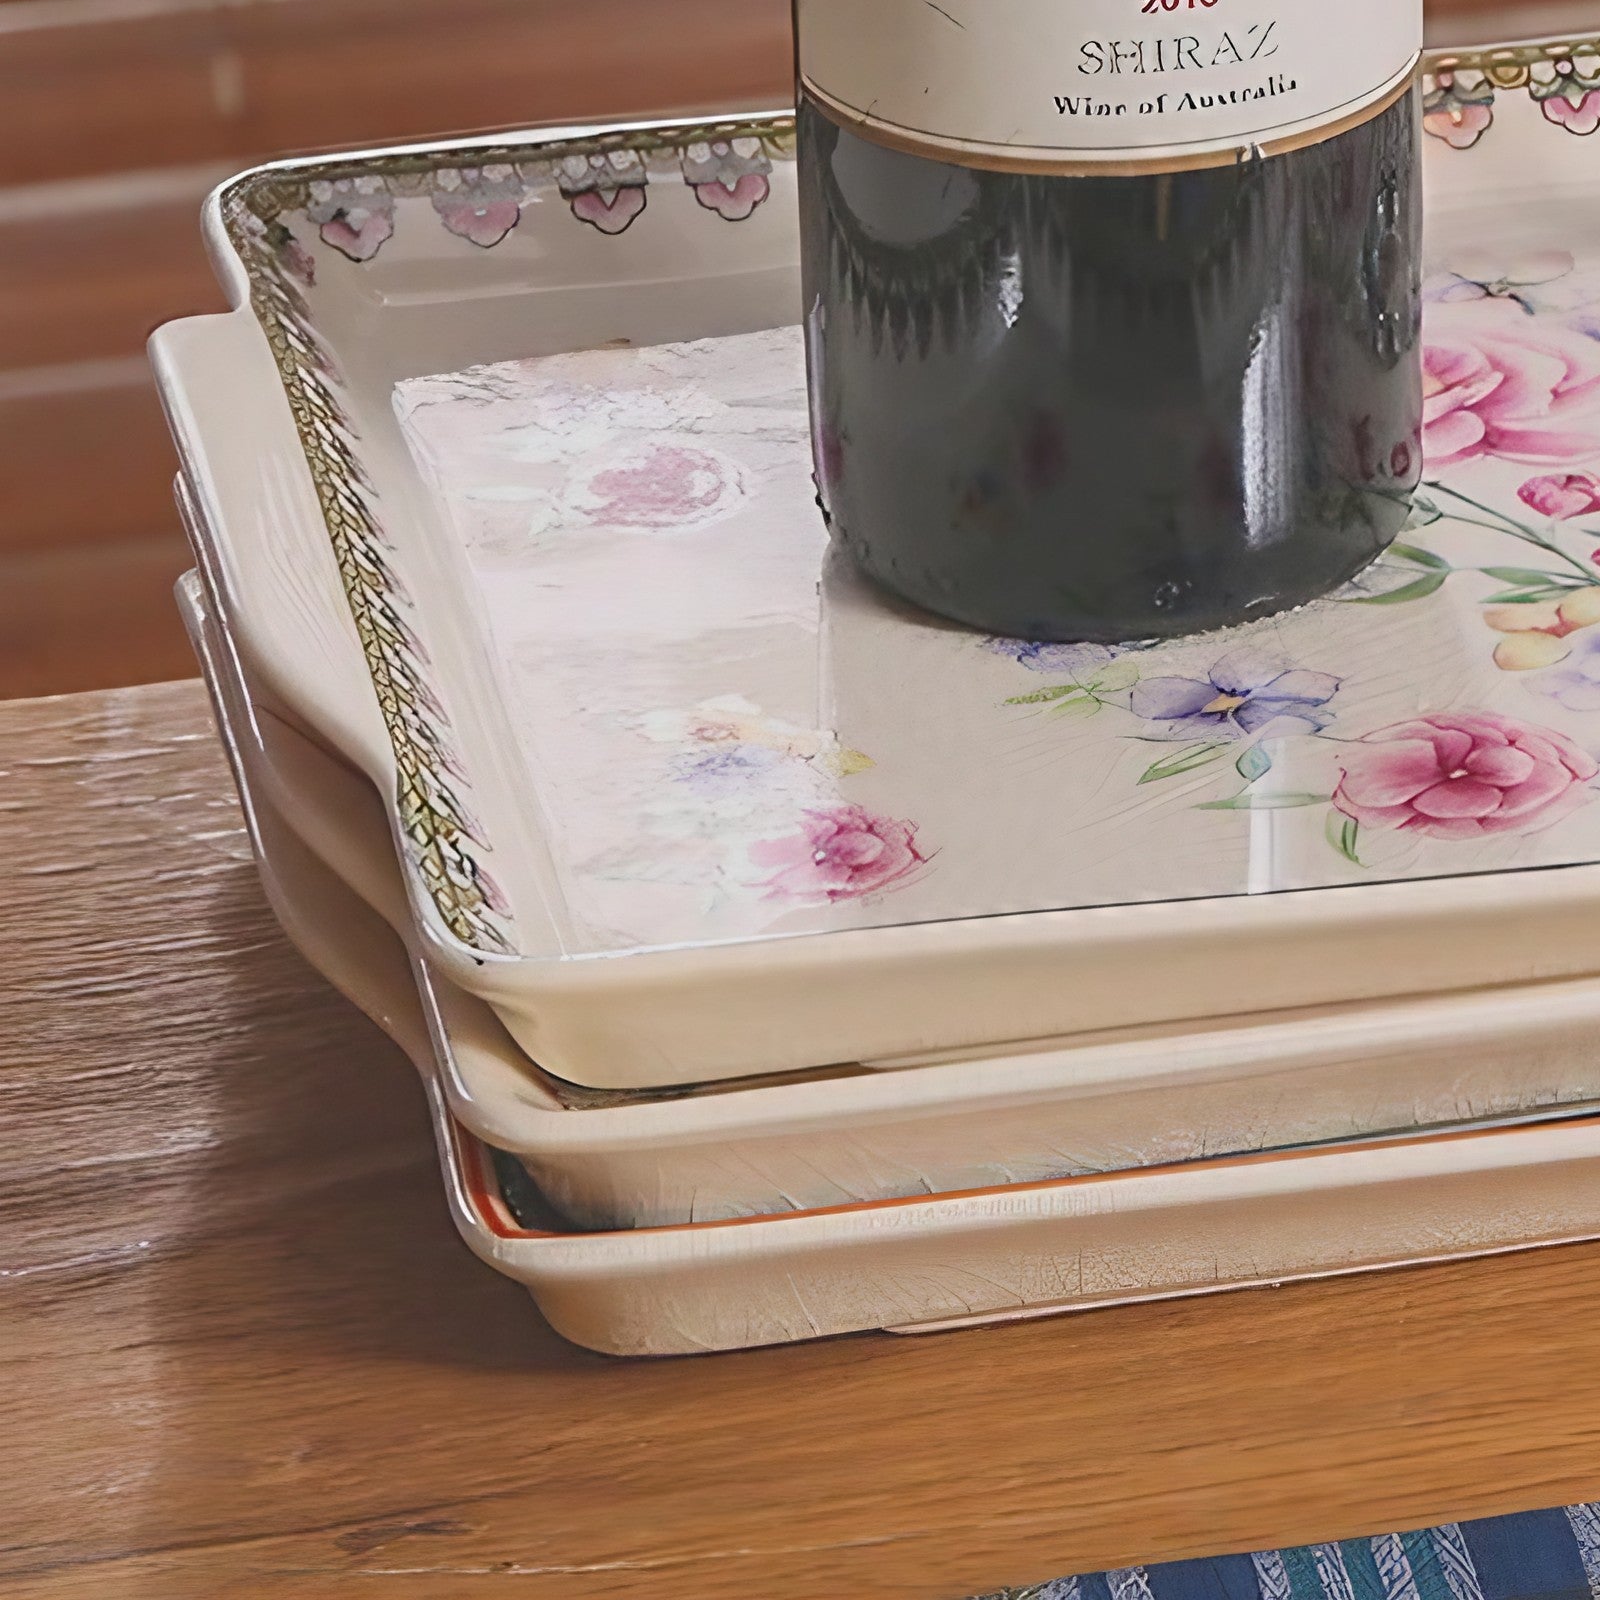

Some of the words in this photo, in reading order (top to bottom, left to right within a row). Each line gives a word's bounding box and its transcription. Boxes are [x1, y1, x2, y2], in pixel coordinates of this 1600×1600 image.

[1076, 20, 1280, 76] SHIRAZ
[1052, 94, 1128, 117] Wine
[1137, 92, 1169, 115] of
[1176, 72, 1298, 113] Australia
